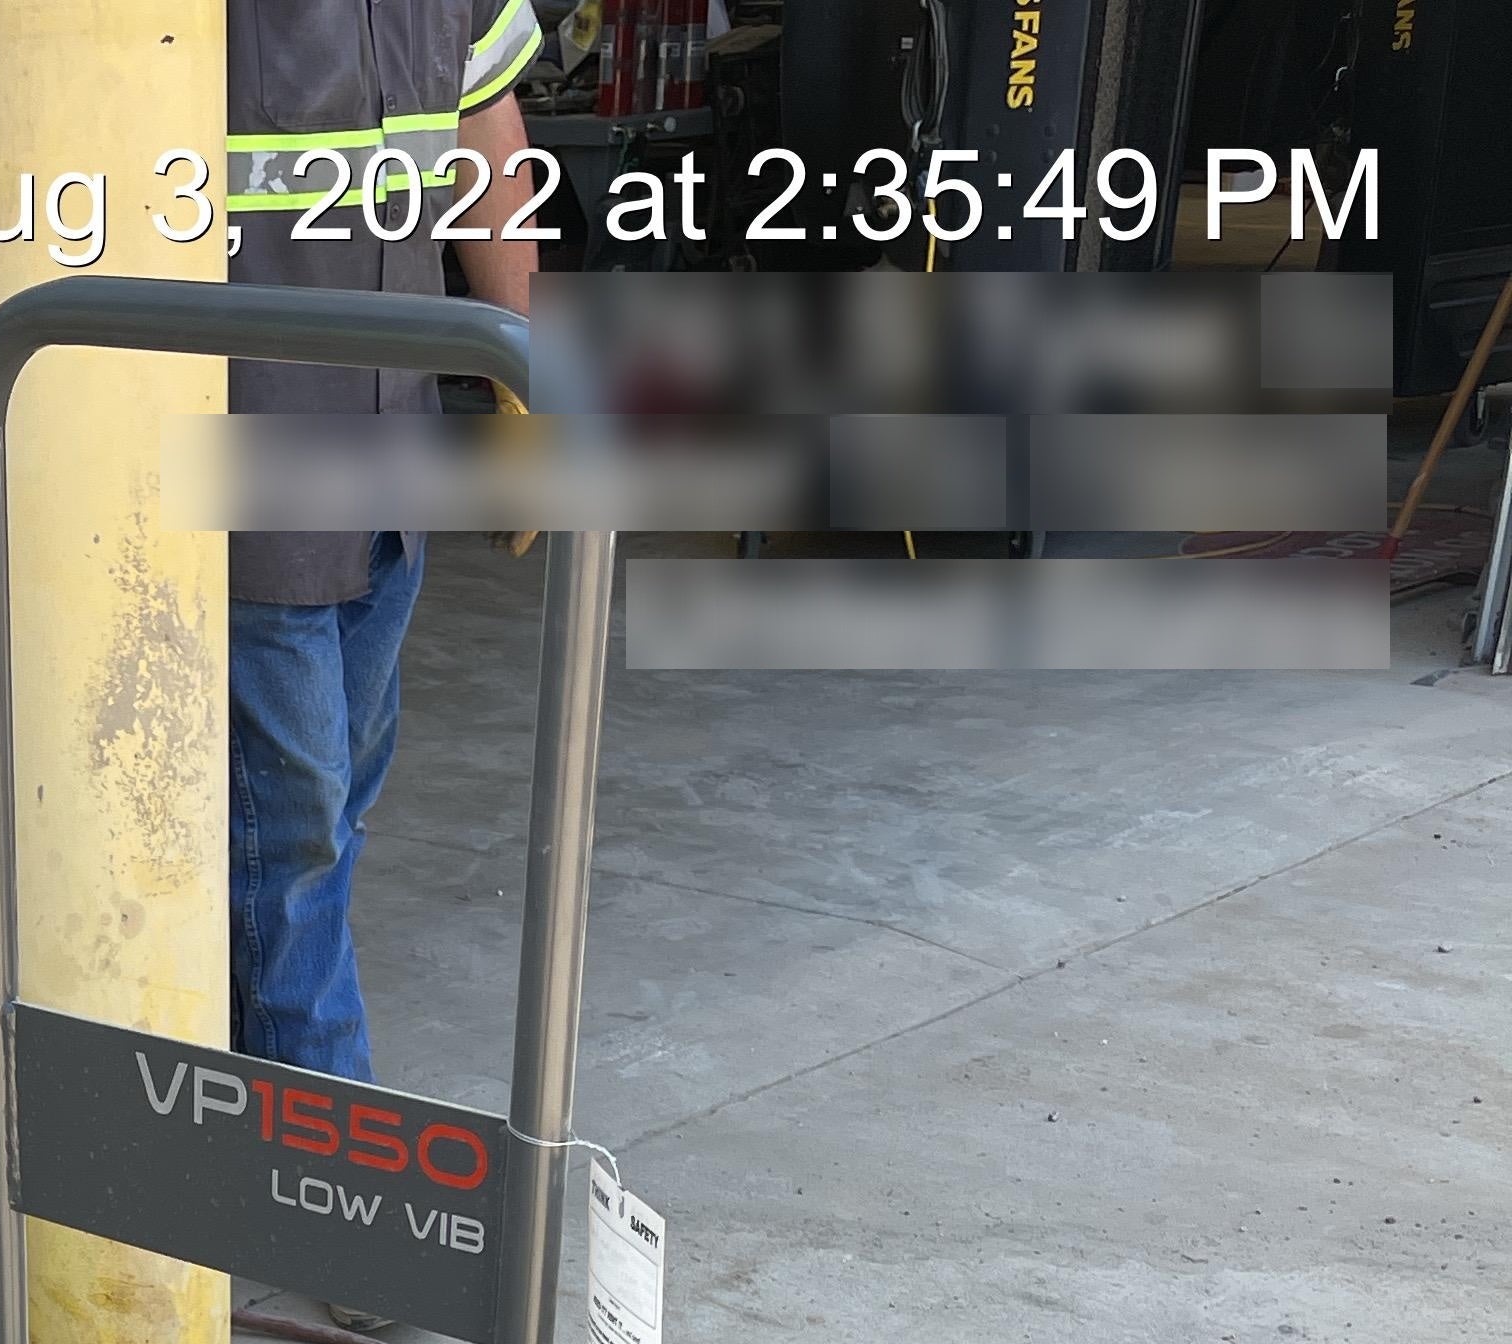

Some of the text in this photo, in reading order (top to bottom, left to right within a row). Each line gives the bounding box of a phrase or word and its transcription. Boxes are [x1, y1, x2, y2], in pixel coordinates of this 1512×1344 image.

[1007, 11, 1041, 109] FANS
[135, 1051, 488, 1191] VP1550
[270, 1168, 485, 1254] LOW VIB
[630, 1215, 659, 1248] SAFETY
